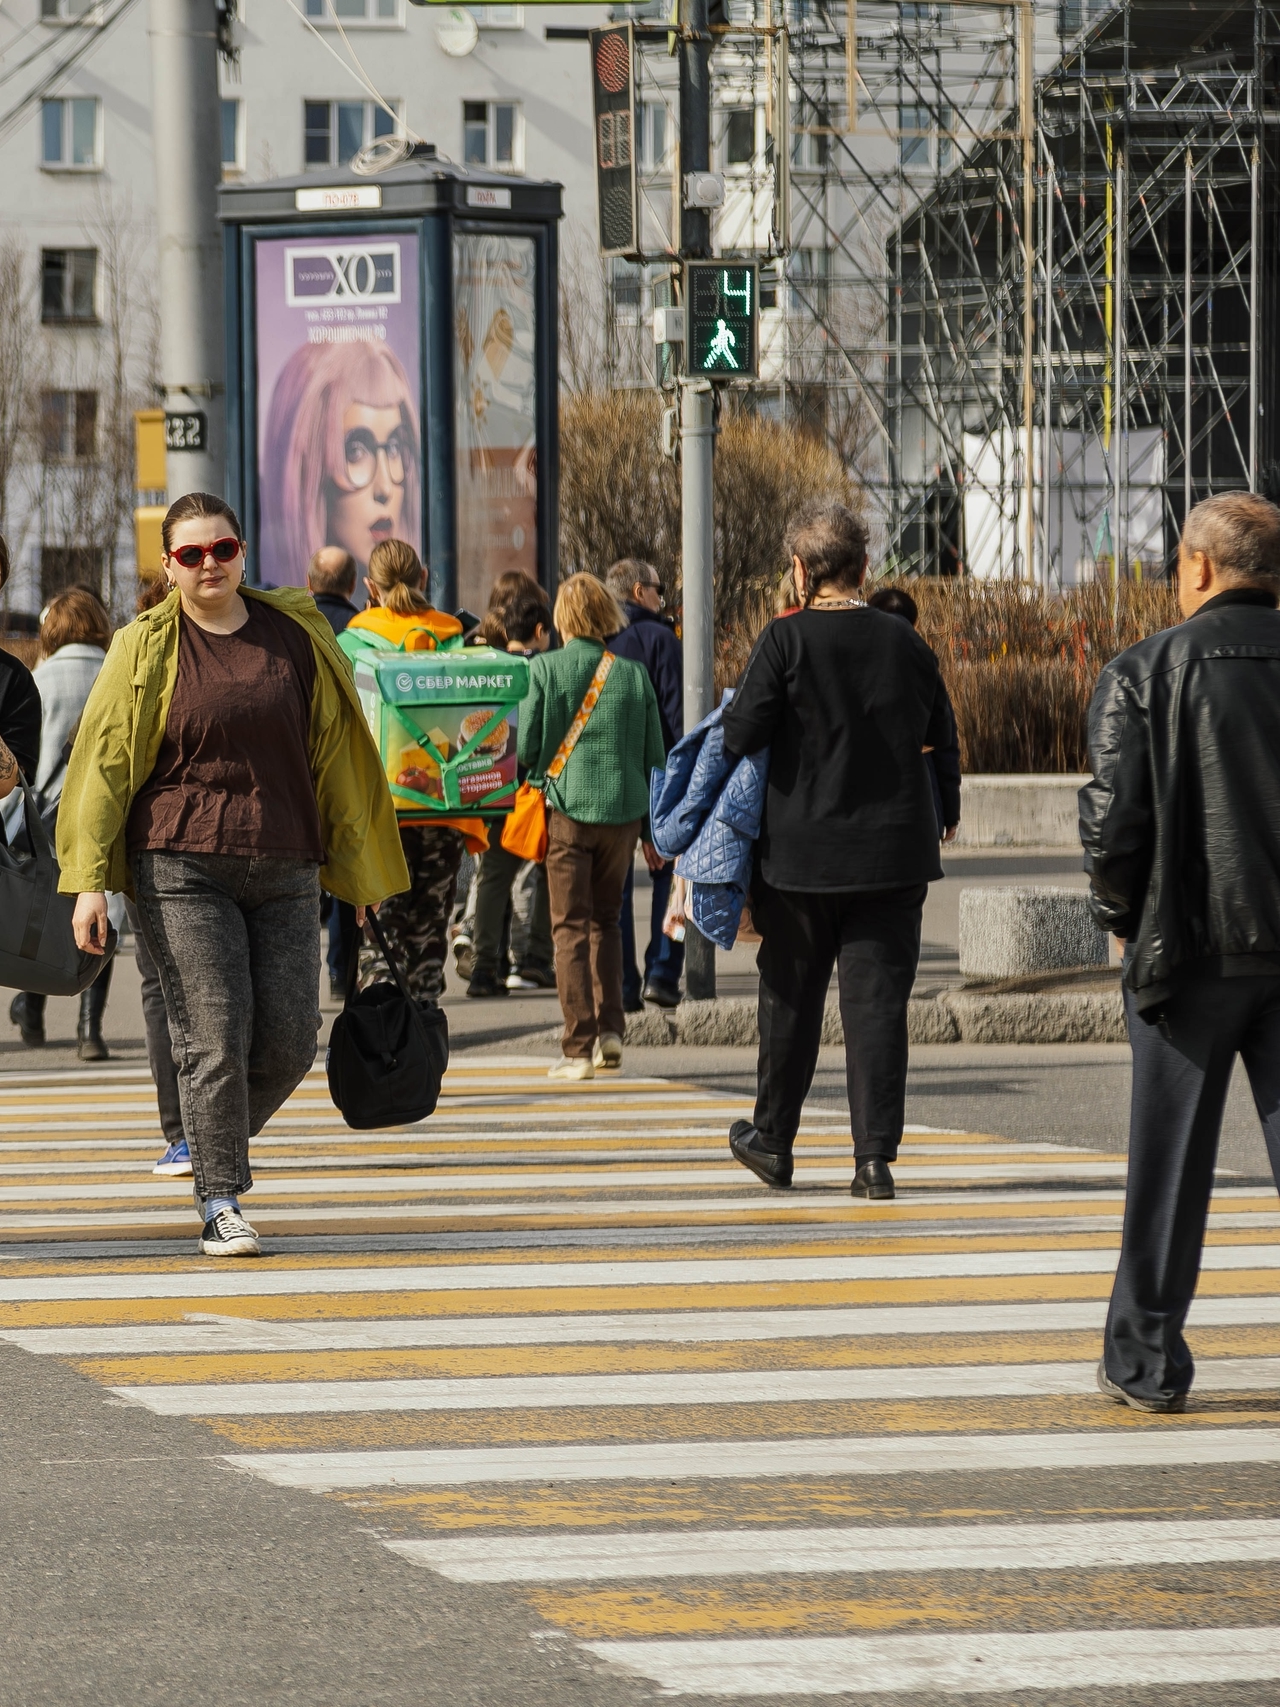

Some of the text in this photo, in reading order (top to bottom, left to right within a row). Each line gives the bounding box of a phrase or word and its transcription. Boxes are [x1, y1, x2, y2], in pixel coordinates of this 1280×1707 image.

[723, 269, 751, 316] 4
[415, 674, 513, 690] СБЕР МАРКЕТ
[456, 758, 493, 774] оставка
[459, 780, 503, 794] сторанов
